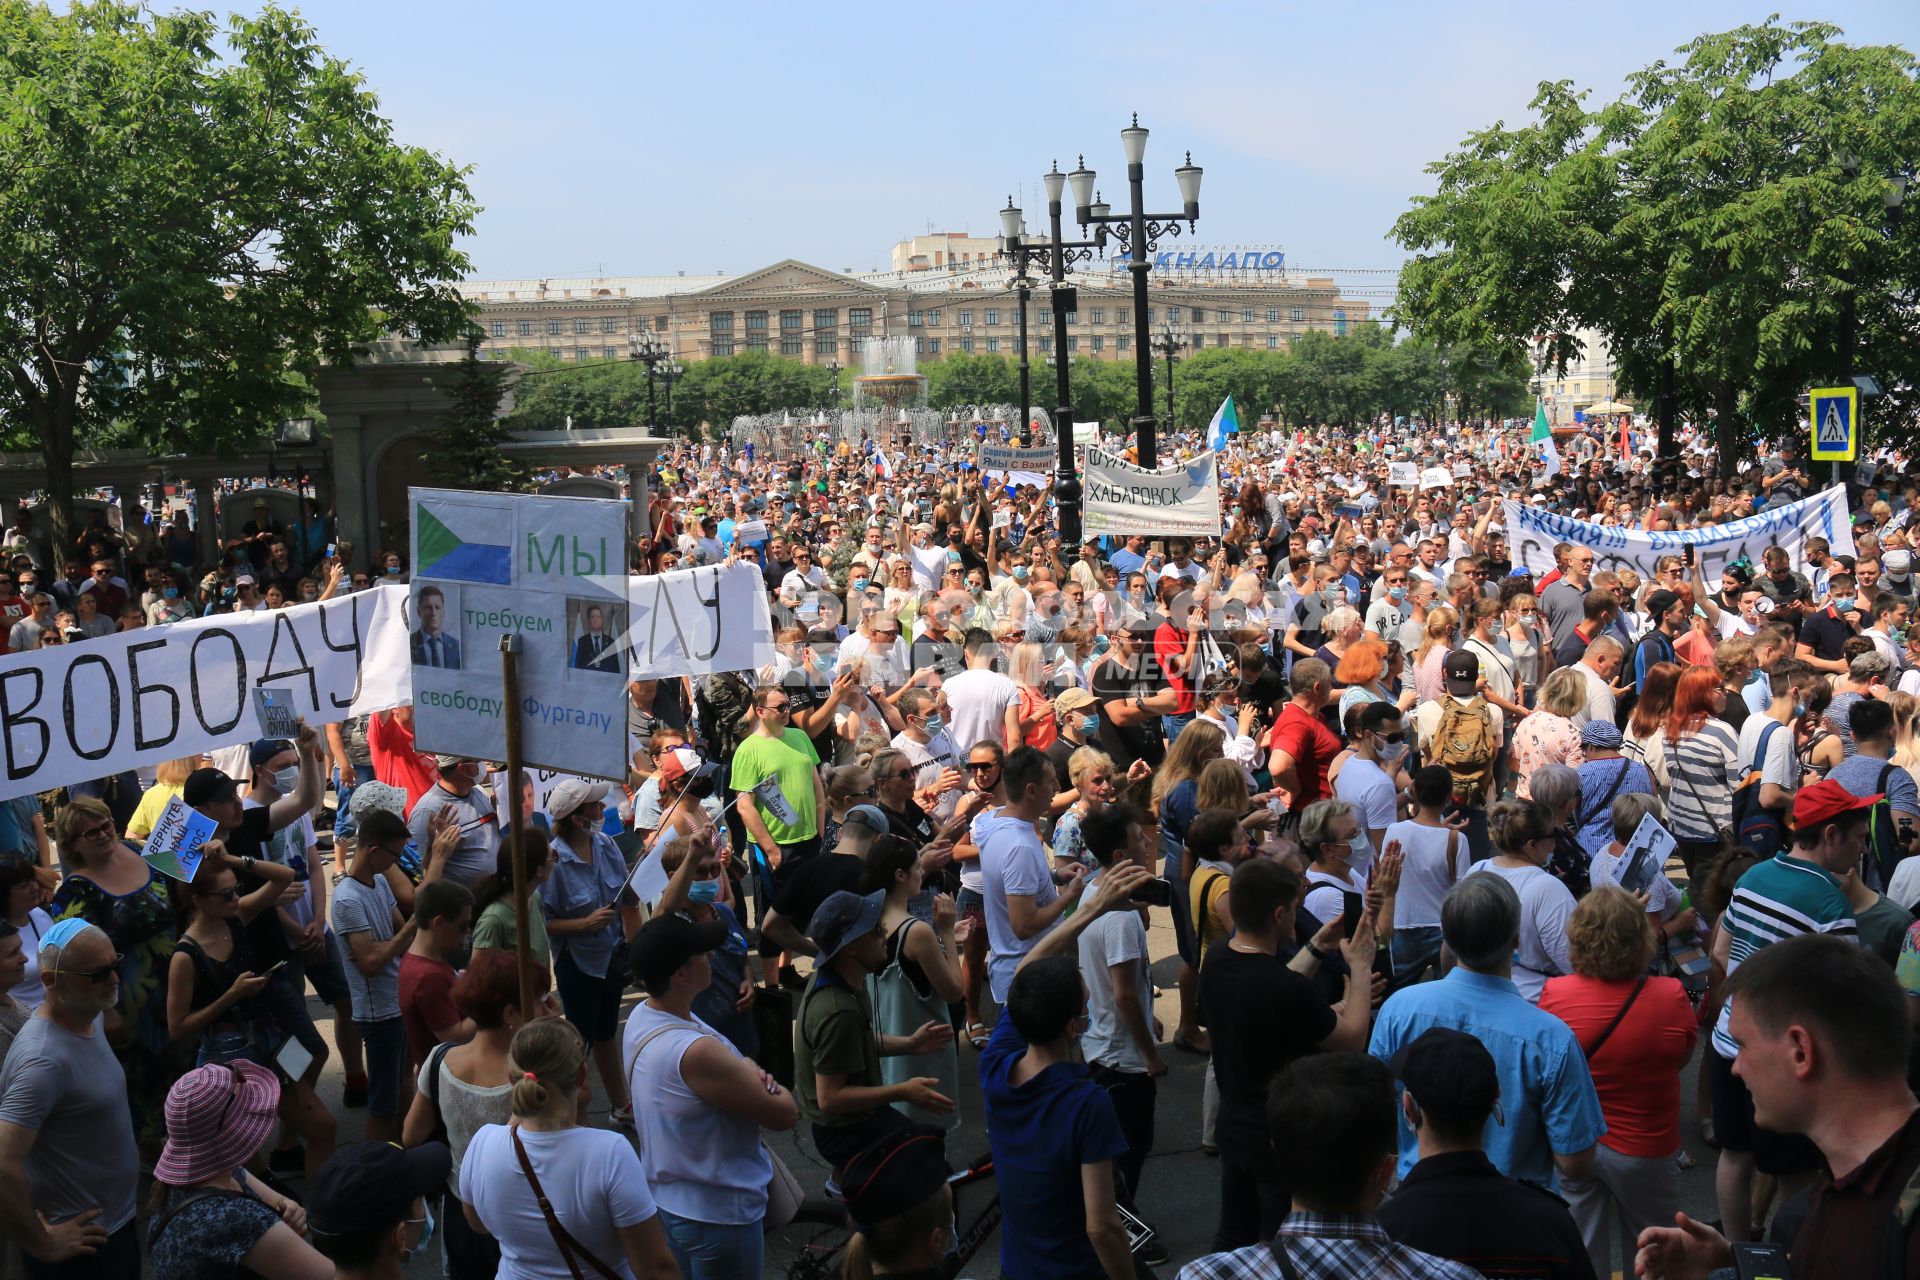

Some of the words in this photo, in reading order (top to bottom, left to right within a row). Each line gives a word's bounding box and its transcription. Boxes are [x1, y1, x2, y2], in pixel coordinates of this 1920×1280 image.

[1154, 251, 1285, 270] КНААПО
[983, 447, 1012, 459] Сергей
[1016, 449, 1054, 459] Иванович
[1022, 460, 1052, 469] Вами!
[1089, 482, 1184, 506] ХАБАРОВСК
[527, 532, 607, 577] МЫ
[465, 607, 552, 633] требуем
[1376, 613, 1406, 631] DREA
[420, 689, 503, 719] свободу
[522, 694, 612, 735] Фургалу
[148, 802, 182, 855] ВЕРНИТЕ
